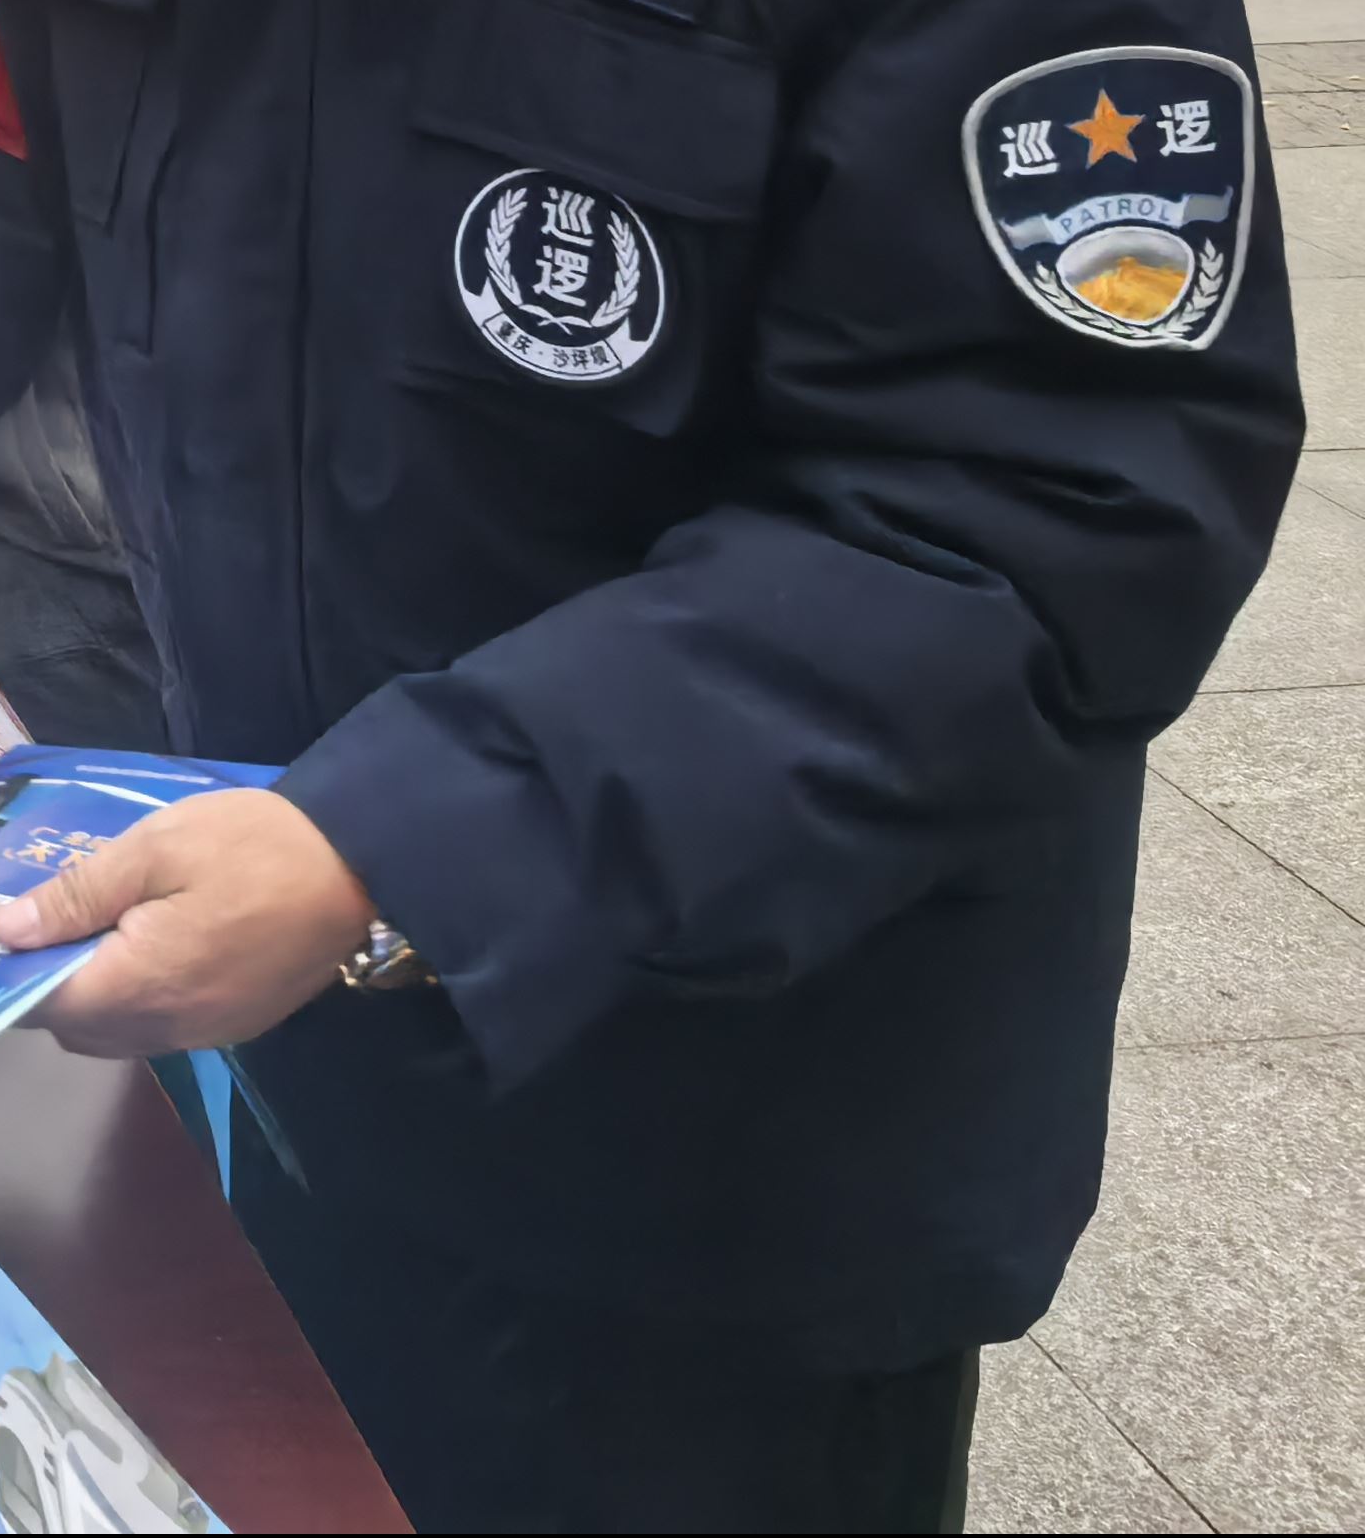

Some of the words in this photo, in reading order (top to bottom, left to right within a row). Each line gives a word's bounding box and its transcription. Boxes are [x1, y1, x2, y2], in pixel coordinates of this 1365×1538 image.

[999, 120, 1060, 178] 巡
[1157, 100, 1217, 157] 逻
[532, 186, 596, 307] 巡逻
[1060, 198, 1173, 233] PATROL
